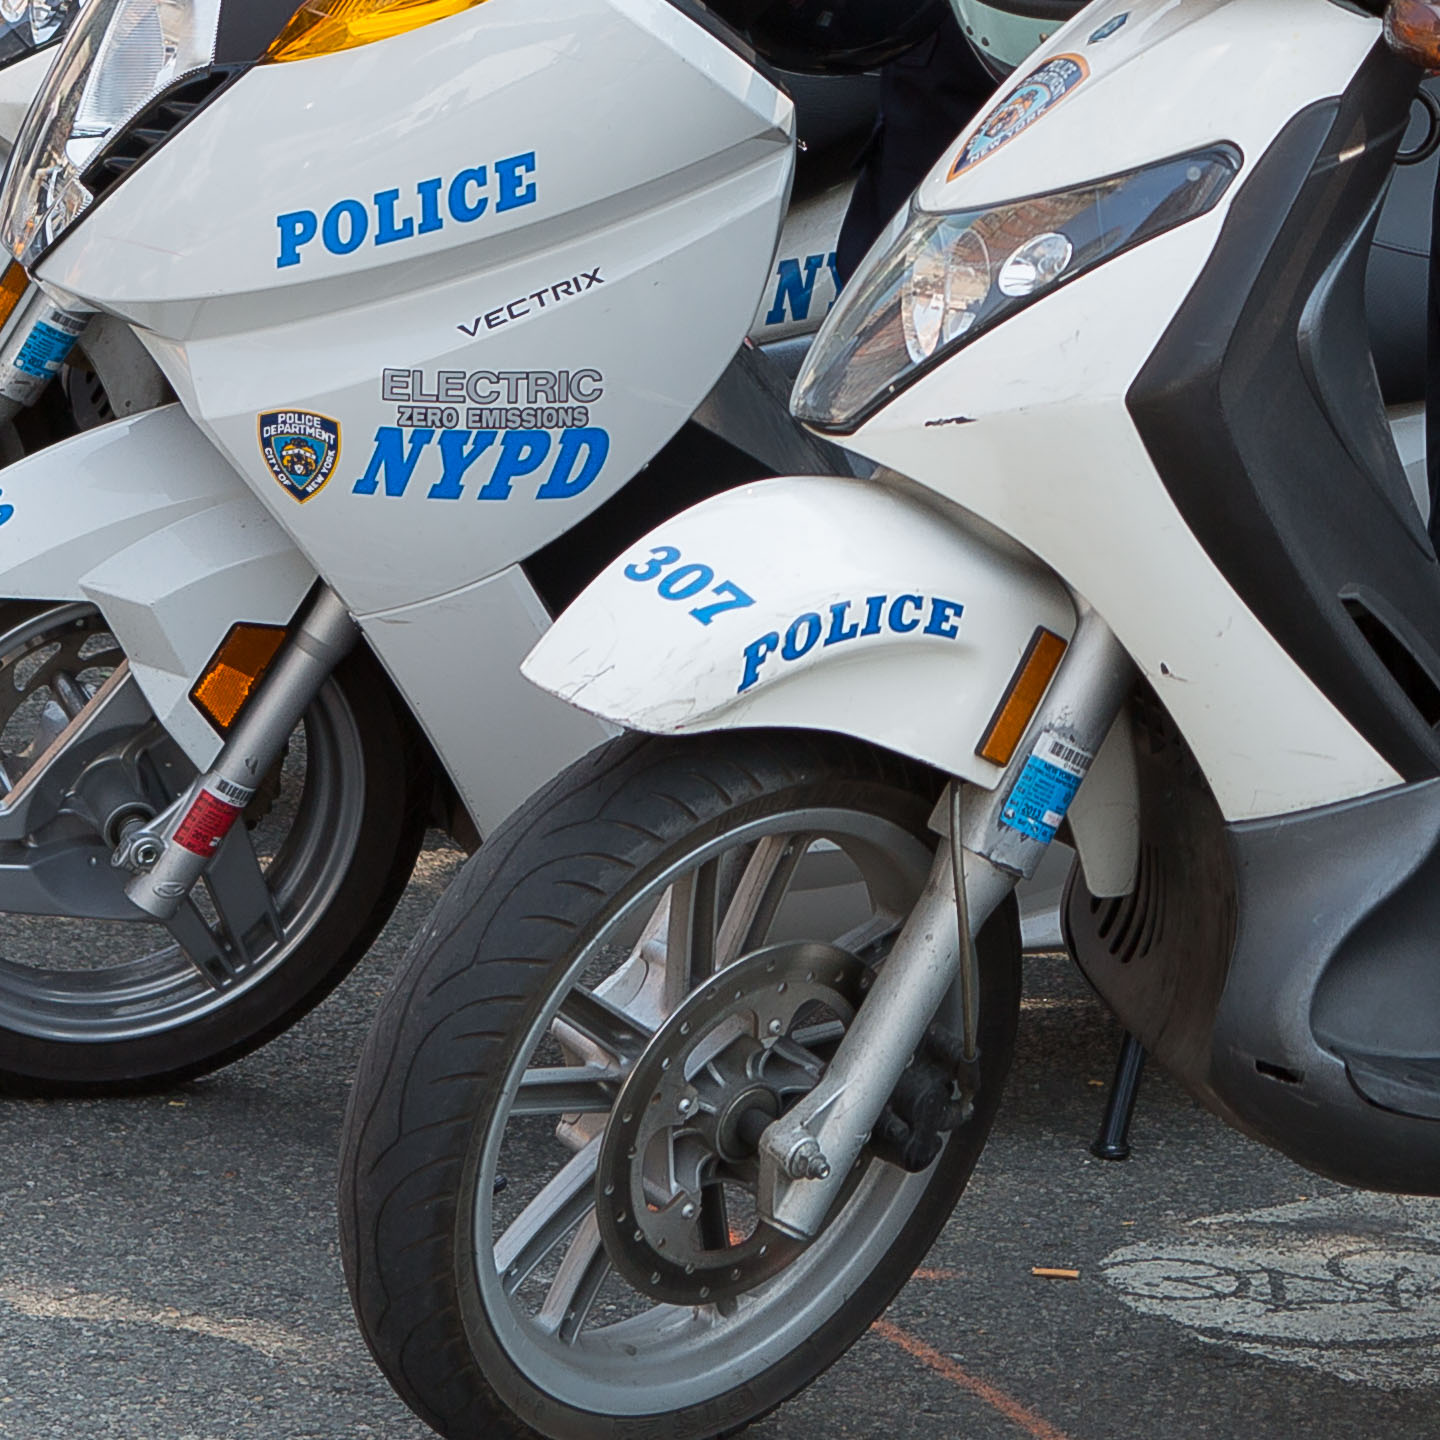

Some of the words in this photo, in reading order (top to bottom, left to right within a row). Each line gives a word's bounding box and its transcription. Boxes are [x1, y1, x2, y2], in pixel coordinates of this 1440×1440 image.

[276, 151, 537, 268] POLICE
[457, 267, 605, 337] VECTRIX
[382, 368, 603, 404] ELECTRIC
[263, 424, 335, 445] DEPARTMENT
[278, 413, 321, 428] POLICE
[397, 405, 459, 428] ZERO
[467, 406, 589, 430] EMISSIONS
[264, 447, 280, 472] CITY
[278, 473, 291, 486] OF
[306, 474, 324, 492] NEW
[321, 450, 335, 473] YORK
[352, 426, 609, 501] NYPD
[623, 545, 757, 626] 307
[736, 594, 964, 694] POLICE
